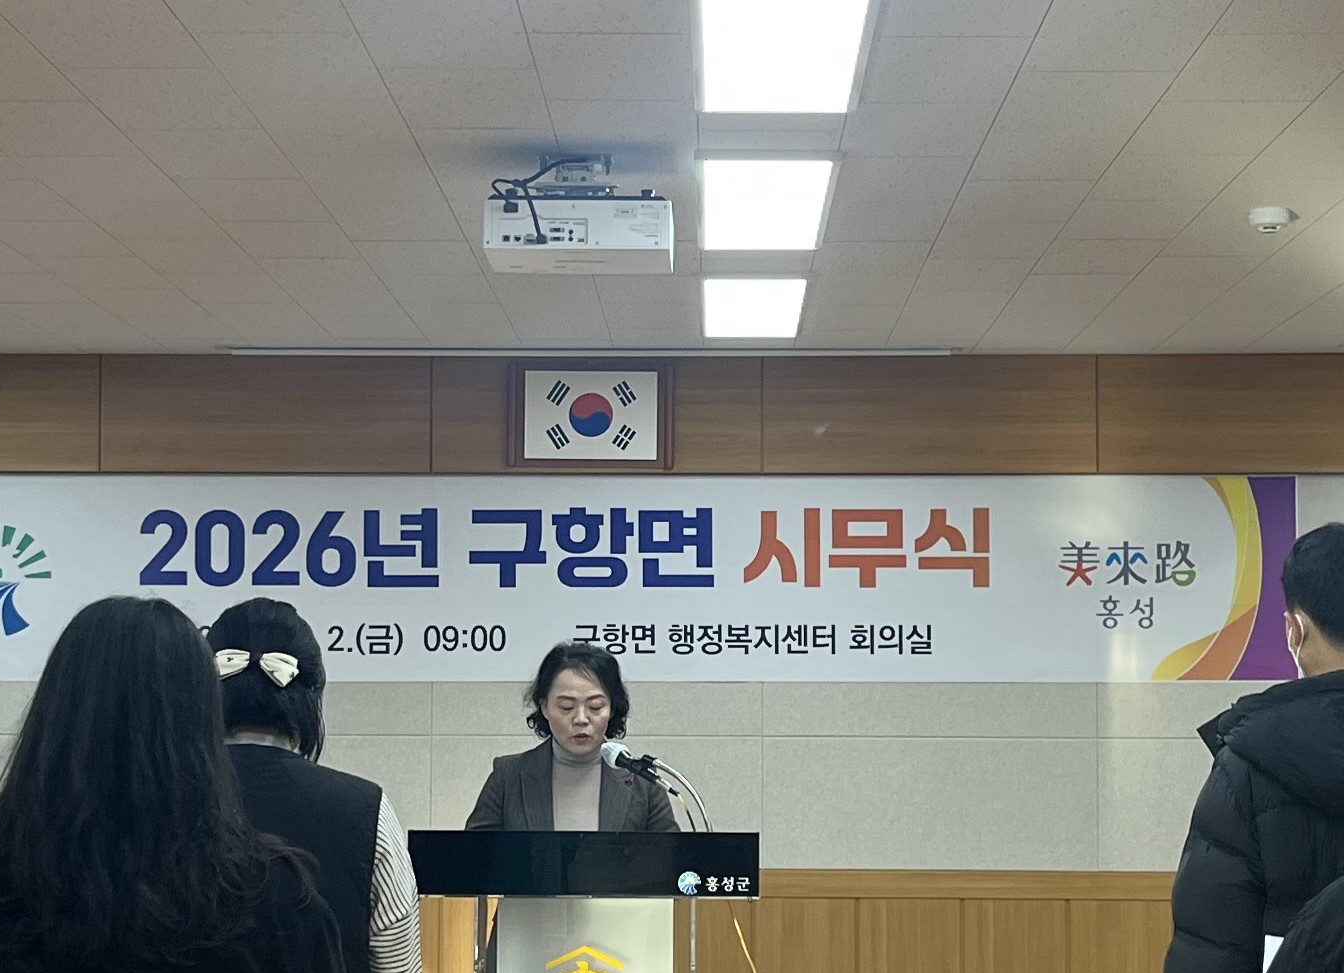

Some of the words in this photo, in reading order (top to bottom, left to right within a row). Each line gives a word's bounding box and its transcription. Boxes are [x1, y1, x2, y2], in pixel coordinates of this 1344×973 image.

[139, 508, 439, 588] 2026년
[469, 507, 716, 588] 구항면
[743, 507, 991, 588] 시무식
[1058, 540, 1196, 586] 美來路
[423, 625, 506, 652] 09:00
[573, 623, 656, 655] 구항면
[668, 623, 836, 655] 행정복지센터
[849, 624, 933, 655] 회의실
[705, 876, 751, 892] 홍성군
